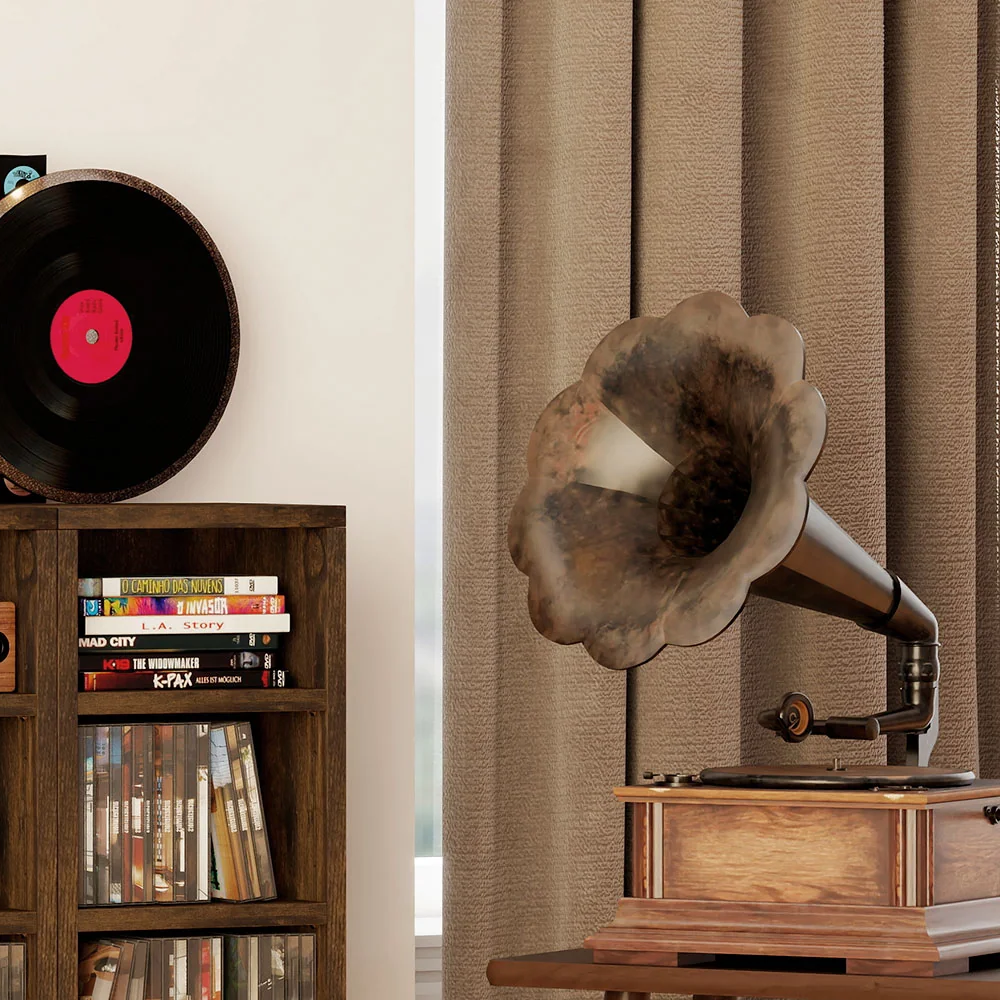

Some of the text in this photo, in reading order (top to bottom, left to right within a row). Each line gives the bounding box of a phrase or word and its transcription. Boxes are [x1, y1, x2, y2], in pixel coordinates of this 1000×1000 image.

[122, 578, 223, 594] O CAMINHO DAS NUVENS
[186, 597, 228, 615] INVASOR
[142, 622, 224, 630] L.A. Story
[79, 636, 136, 648] MAD CITY
[133, 658, 146, 669] THE
[148, 657, 199, 669] WIDOWMAKER
[153, 672, 193, 688] K-PAX
[195, 676, 209, 684] ALLES
